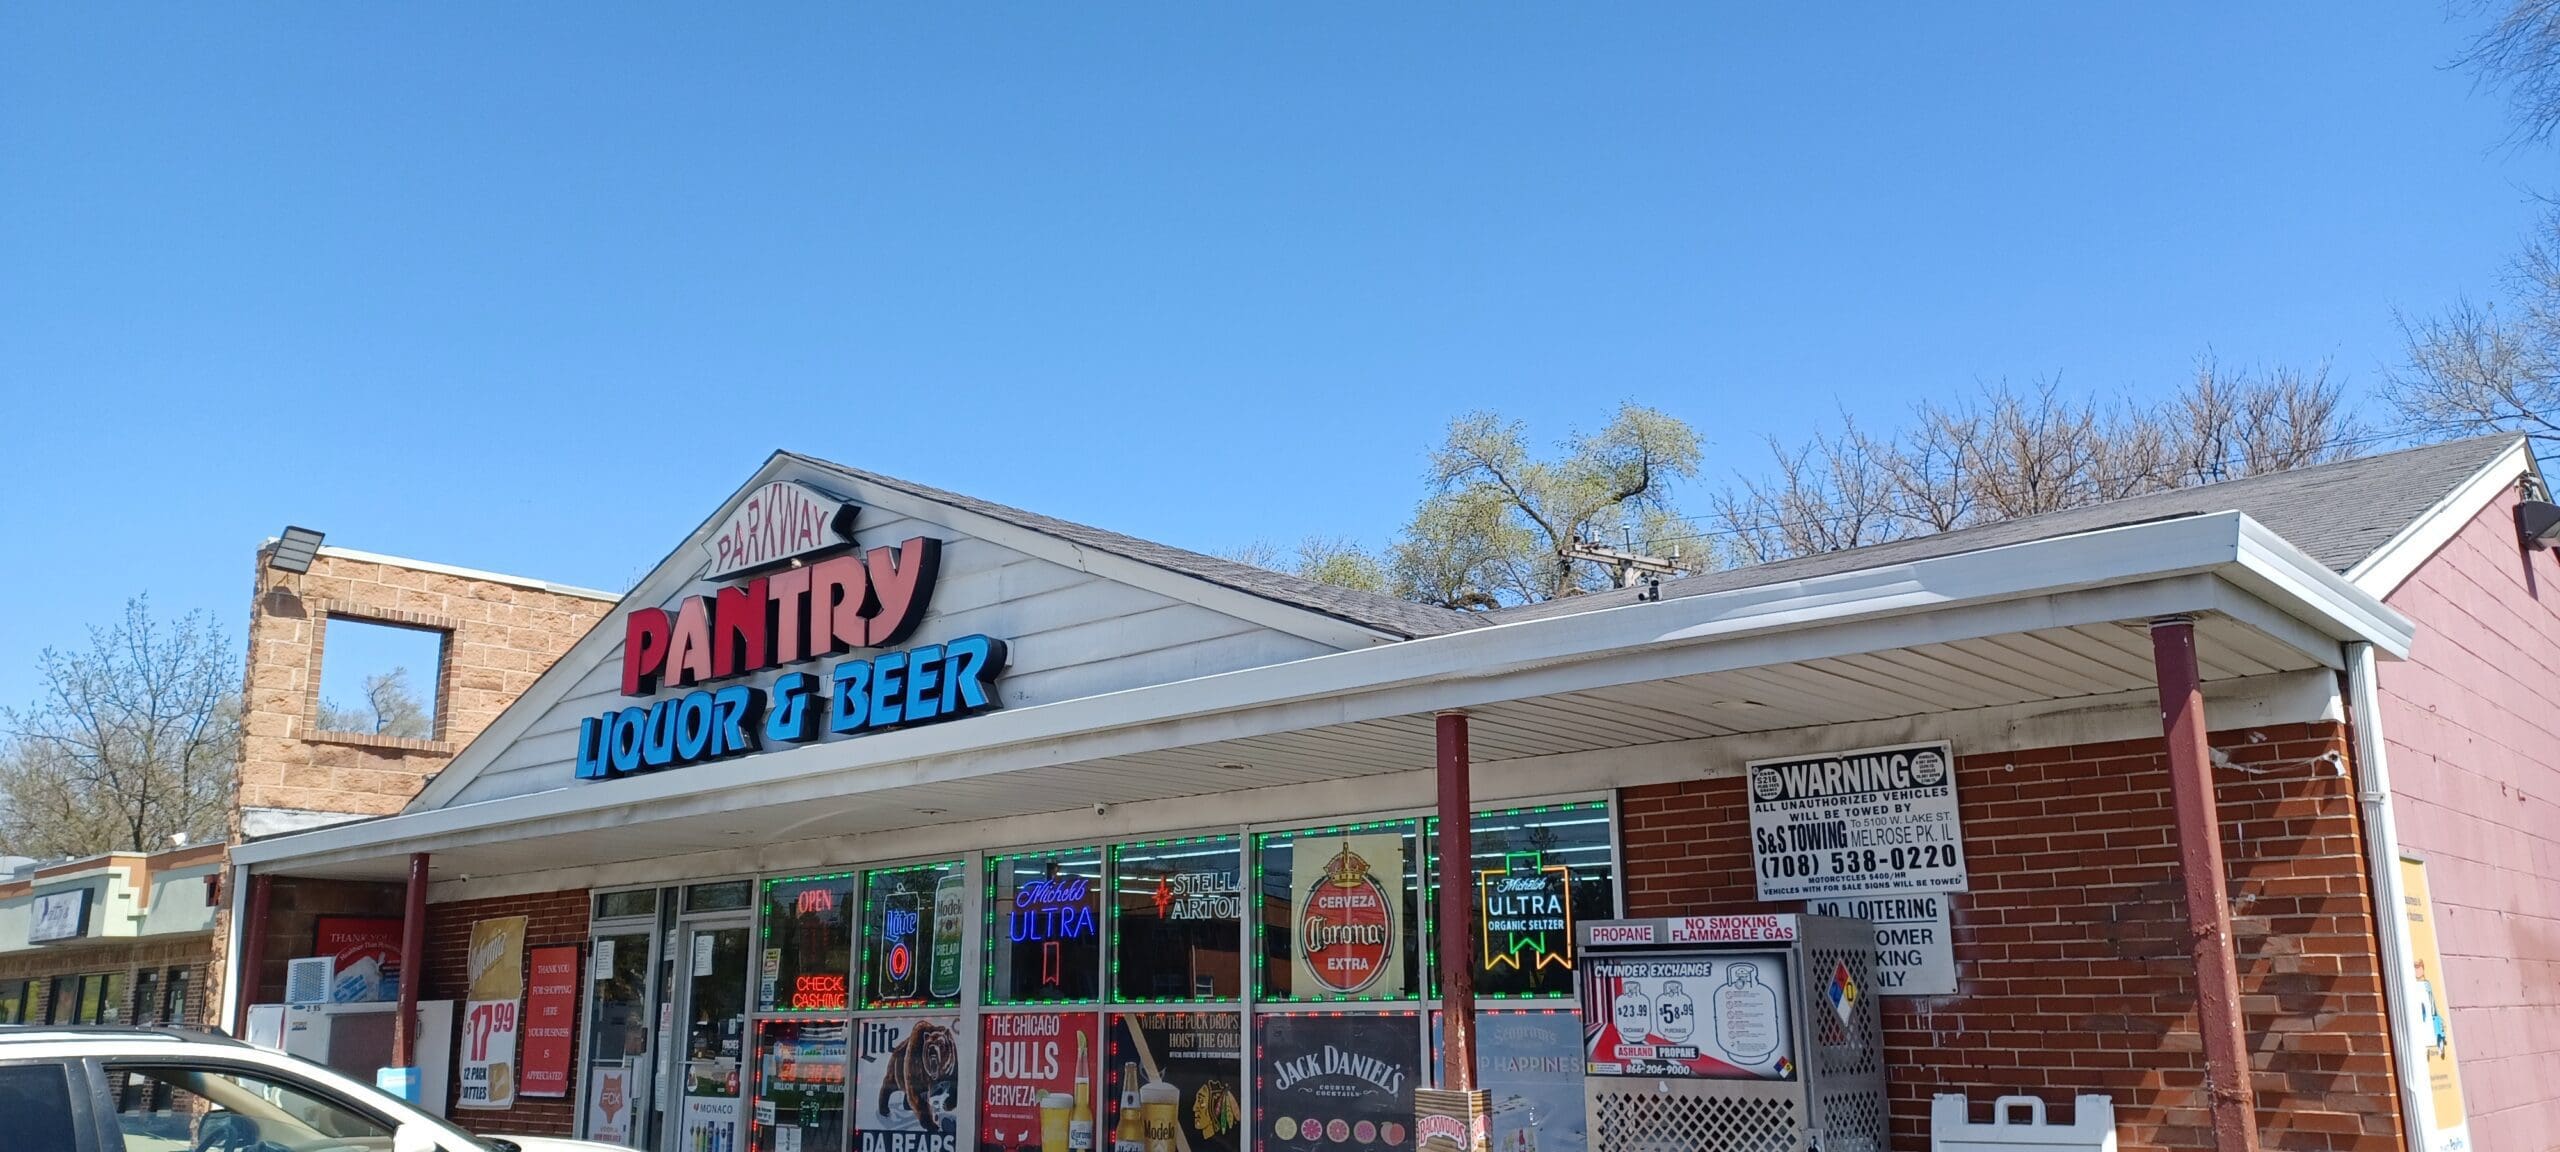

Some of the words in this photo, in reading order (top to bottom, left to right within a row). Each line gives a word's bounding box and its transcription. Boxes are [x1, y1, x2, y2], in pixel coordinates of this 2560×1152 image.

[717, 483, 829, 573] PARKWAY
[621, 537, 930, 697] PANTRY
[575, 685, 756, 780] LIQUOR
[767, 672, 816, 742] &
[831, 634, 995, 734] BEER
[1781, 754, 1909, 798] WARNING
[1755, 802, 1776, 813] ALL
[1782, 793, 1877, 811] UNAUTHORIZED
[1883, 788, 1949, 801] VEHICLES
[1789, 811, 1820, 822] WILL
[1824, 810, 1840, 820] BE
[1845, 806, 1889, 818] TOWED
[1895, 803, 1912, 813] BY
[1851, 818, 1862, 828] To
[1864, 816, 1887, 827] 5100
[1889, 815, 1903, 825] W.
[1905, 813, 1933, 824] LAKE
[1936, 812, 1952, 822] ST.
[1756, 826, 1786, 855] S&S
[1788, 821, 1848, 852] TOWING
[1851, 827, 1912, 848] MELROSE
[1916, 829, 1938, 843] PK.
[1942, 829, 1954, 841] IL
[1762, 853, 1820, 878] (708)
[1831, 844, 1957, 874] 538-0220
[1764, 887, 1800, 895] VEHICLES
[1802, 885, 1821, 893] WITH
[1823, 884, 1839, 892] FOR
[1841, 882, 1862, 891] SALE
[1865, 881, 1890, 890] SIGNS
[1893, 880, 1914, 888] WILL
[1916, 878, 1928, 887] BE
[1930, 877, 1962, 887] TOWED
[1808, 874, 1867, 884] MOTORCYCLES
[798, 889, 833, 914] OPEN
[1171, 896, 1241, 920] ARTOI
[1318, 895, 1377, 909] CERVEZA
[1488, 895, 1563, 916] ULTRA
[1818, 902, 1839, 917] NO
[1849, 898, 1938, 920] LOITERING
[885, 908, 917, 943] Lite
[1009, 906, 1096, 942] ULTRA
[1488, 918, 1527, 932] ORGANIC
[1528, 918, 1565, 932] SELTZER
[1685, 917, 1705, 930] NO
[1709, 916, 1778, 930] SMOKING
[1303, 915, 1386, 953] Corona
[1592, 927, 1653, 942] PROPANE
[1672, 928, 1759, 942] FLAMMABLE
[1763, 926, 1794, 940] GAS
[537, 965, 557, 974] THANK
[558, 964, 570, 974] YOU
[1327, 957, 1369, 970] EXTRA
[1594, 963, 1648, 978] CYLINDER
[1651, 962, 1712, 977] EXCHANGE
[532, 985, 544, 996] FOR
[544, 985, 572, 995] SHOPPING
[796, 975, 845, 991] CHECK
[793, 993, 845, 1009] CASHING
[991, 1015, 1011, 1036] THE
[1012, 1015, 1060, 1036] CHICAGO
[1141, 1015, 1167, 1030] WHEN
[1167, 1014, 1185, 1030] THE
[1185, 1014, 1208, 1030] PUCK
[861, 1022, 900, 1063] Lite
[1169, 1033, 1195, 1048] HOIST
[1198, 1033, 1216, 1048] THE
[989, 1041, 1059, 1080] BULLS
[1618, 1047, 1653, 1057] ASHLAND
[1659, 1047, 1697, 1058] PROPANE
[1273, 1053, 1323, 1091] JACK
[1324, 1044, 1405, 1095] DANIEL'S
[1495, 1056, 1584, 1073] HAPPINES
[1626, 1063, 1691, 1076] 866-206-9000
[601, 1093, 621, 1105] FOX
[988, 1085, 1036, 1107] CERVEZA
[700, 1104, 733, 1114] MONACO
[1144, 1120, 1175, 1140] Modelo
[1418, 1114, 1468, 1151] BACKWOODS
[862, 1132, 886, 1152] DA
[891, 1133, 955, 1152] BEARS
